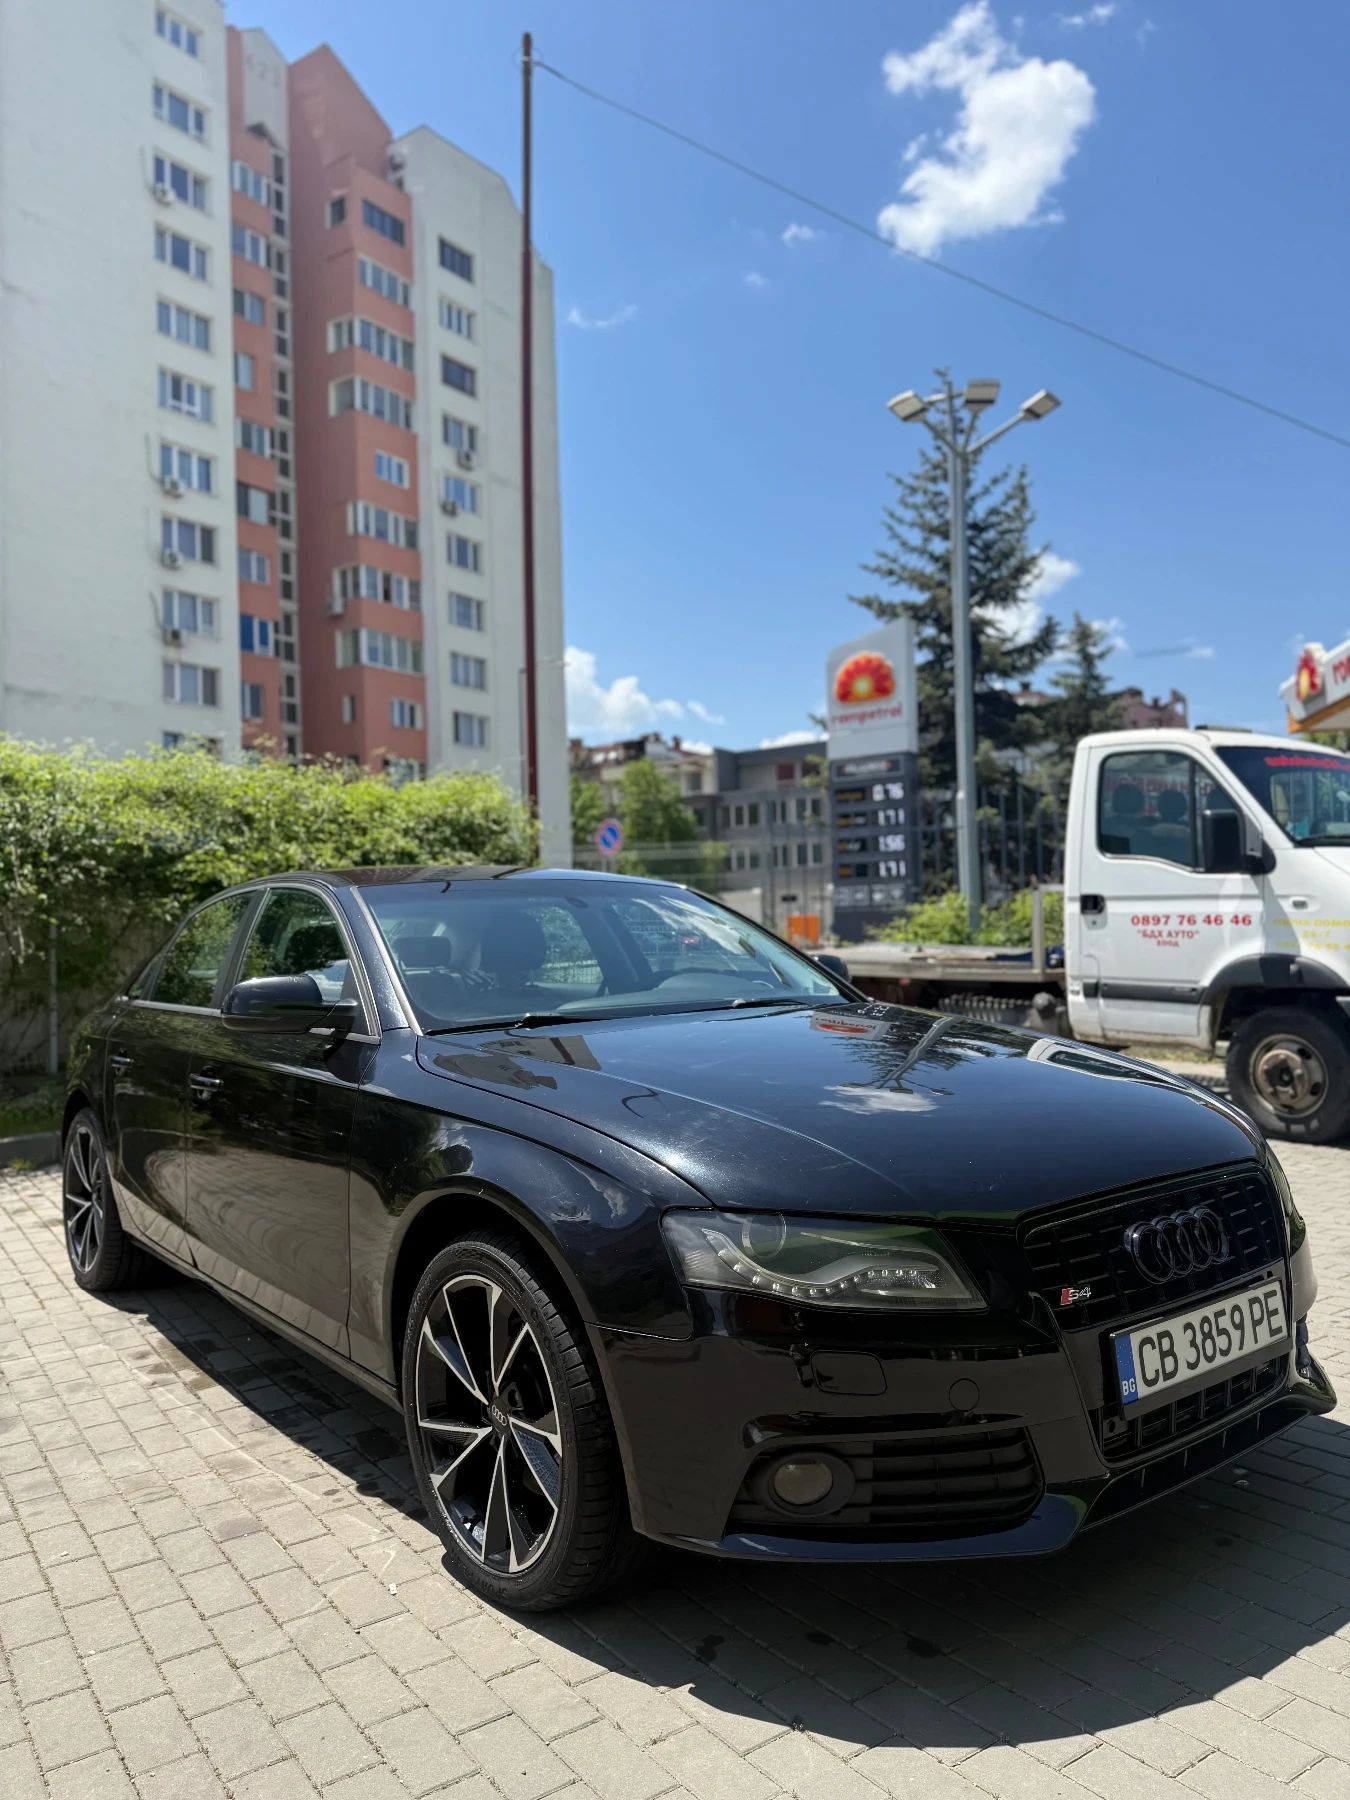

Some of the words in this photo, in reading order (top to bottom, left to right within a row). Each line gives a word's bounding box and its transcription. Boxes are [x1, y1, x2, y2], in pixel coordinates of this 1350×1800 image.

[1131, 914, 1171, 926] 0897
[1177, 914, 1197, 926] 76
[1203, 914, 1224, 926] 46
[1230, 914, 1252, 926] 46
[1139, 1330, 1178, 1387] CB
[1183, 1304, 1245, 1370] 3859
[1248, 1290, 1283, 1344] PE
[1122, 1379, 1136, 1396] BG
